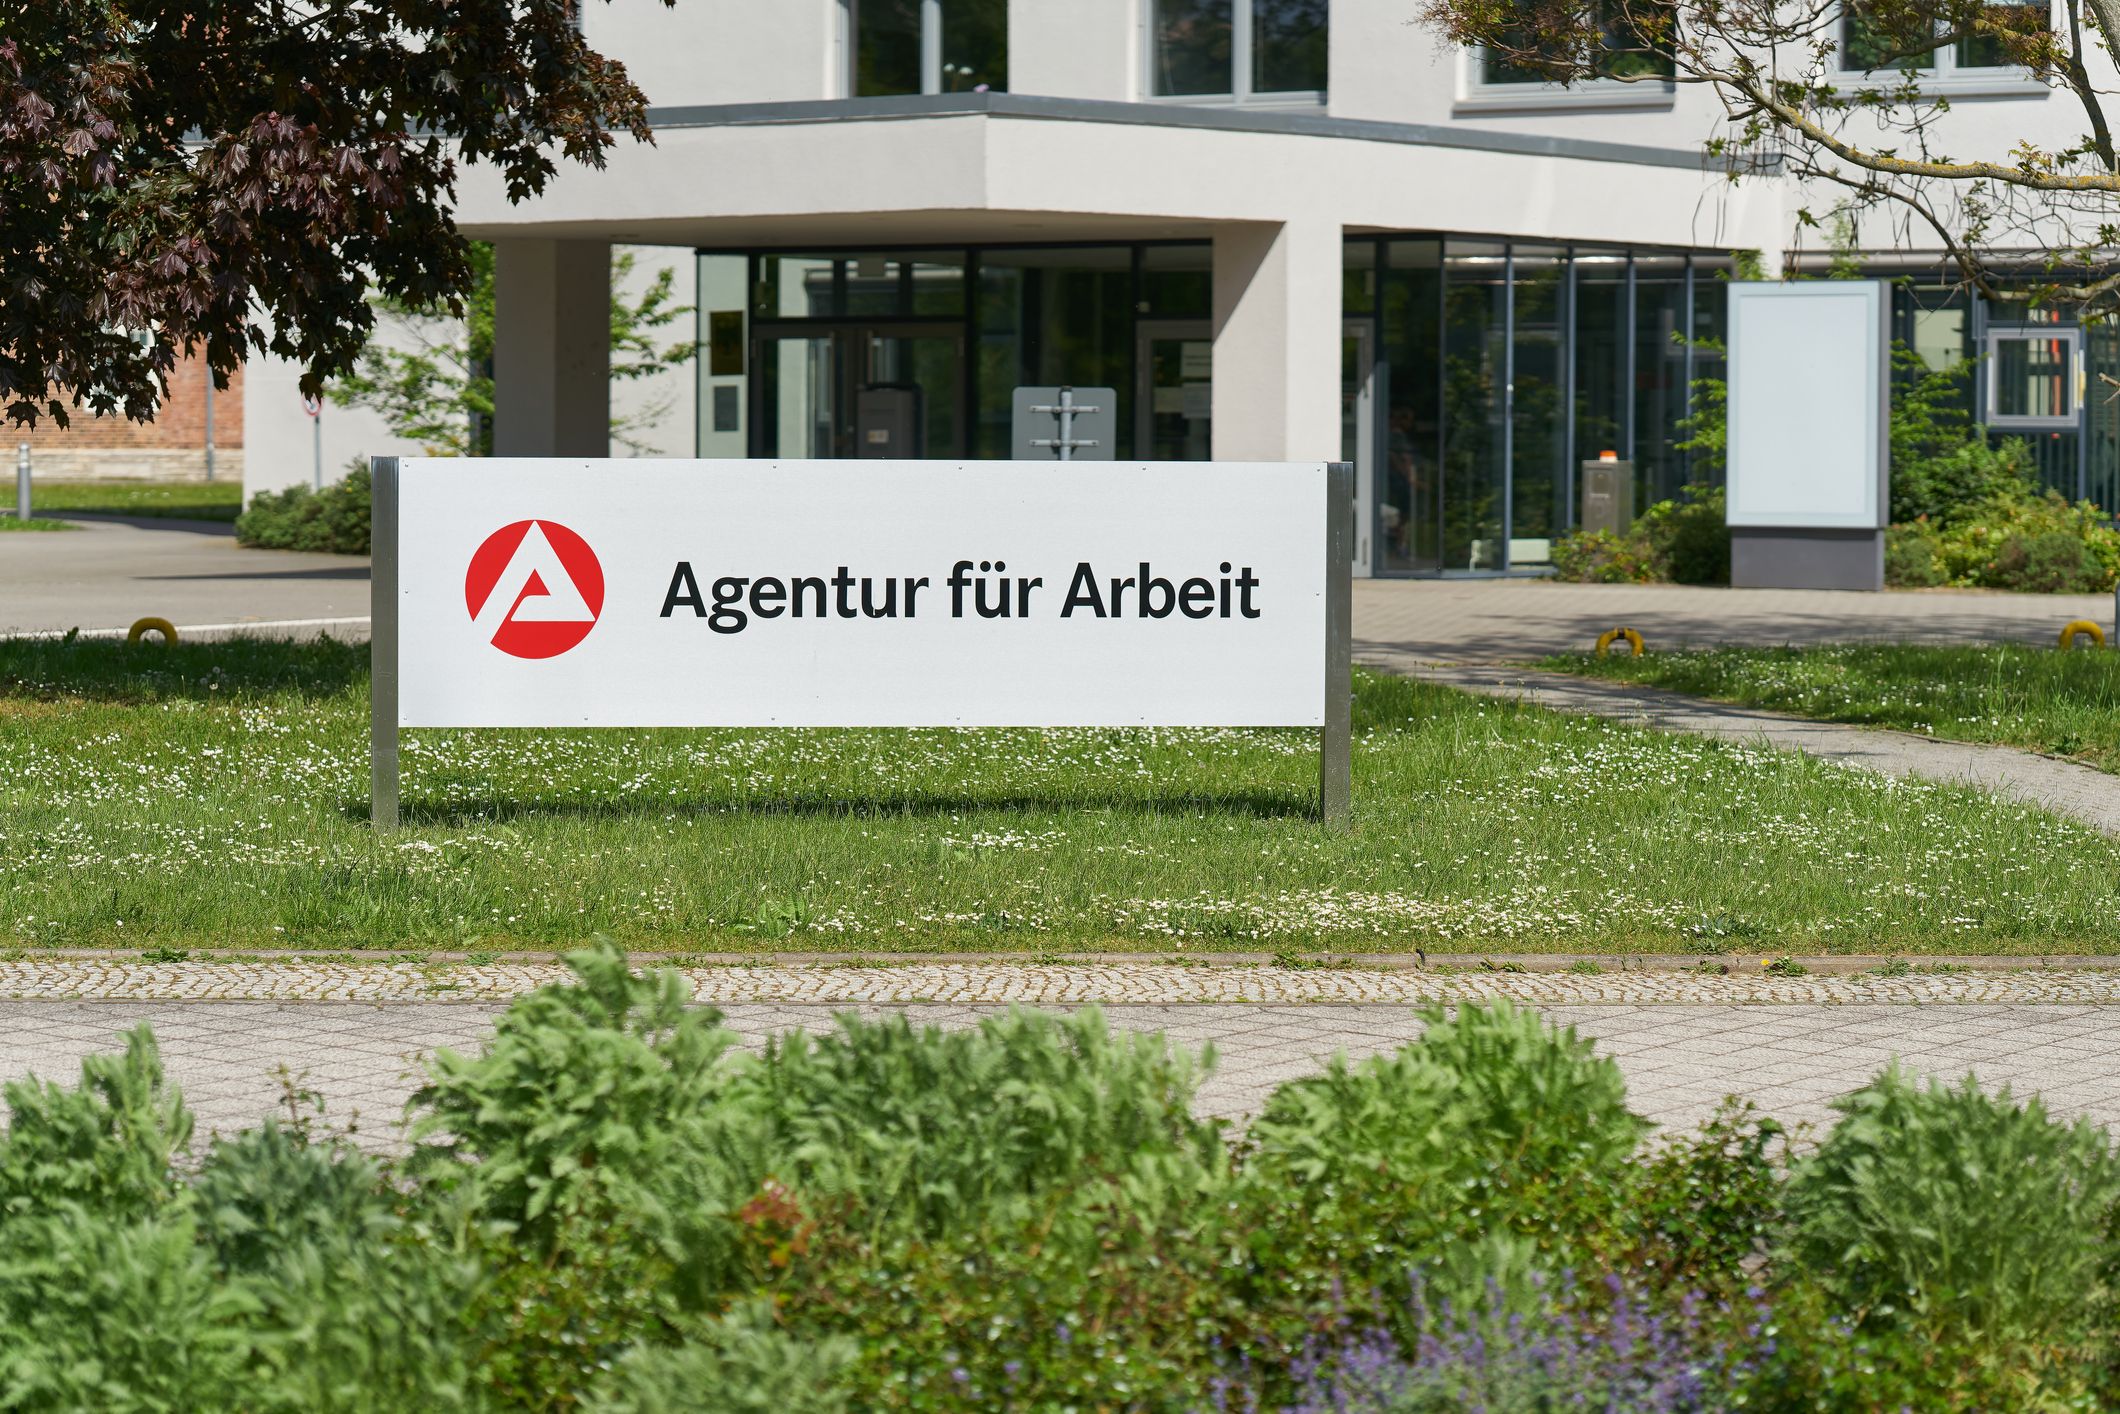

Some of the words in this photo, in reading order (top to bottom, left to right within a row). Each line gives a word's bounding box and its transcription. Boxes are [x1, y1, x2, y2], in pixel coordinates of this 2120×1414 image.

[659, 561, 930, 635] Agentur
[947, 560, 1043, 619] für
[1059, 561, 1261, 620] Arbeit
